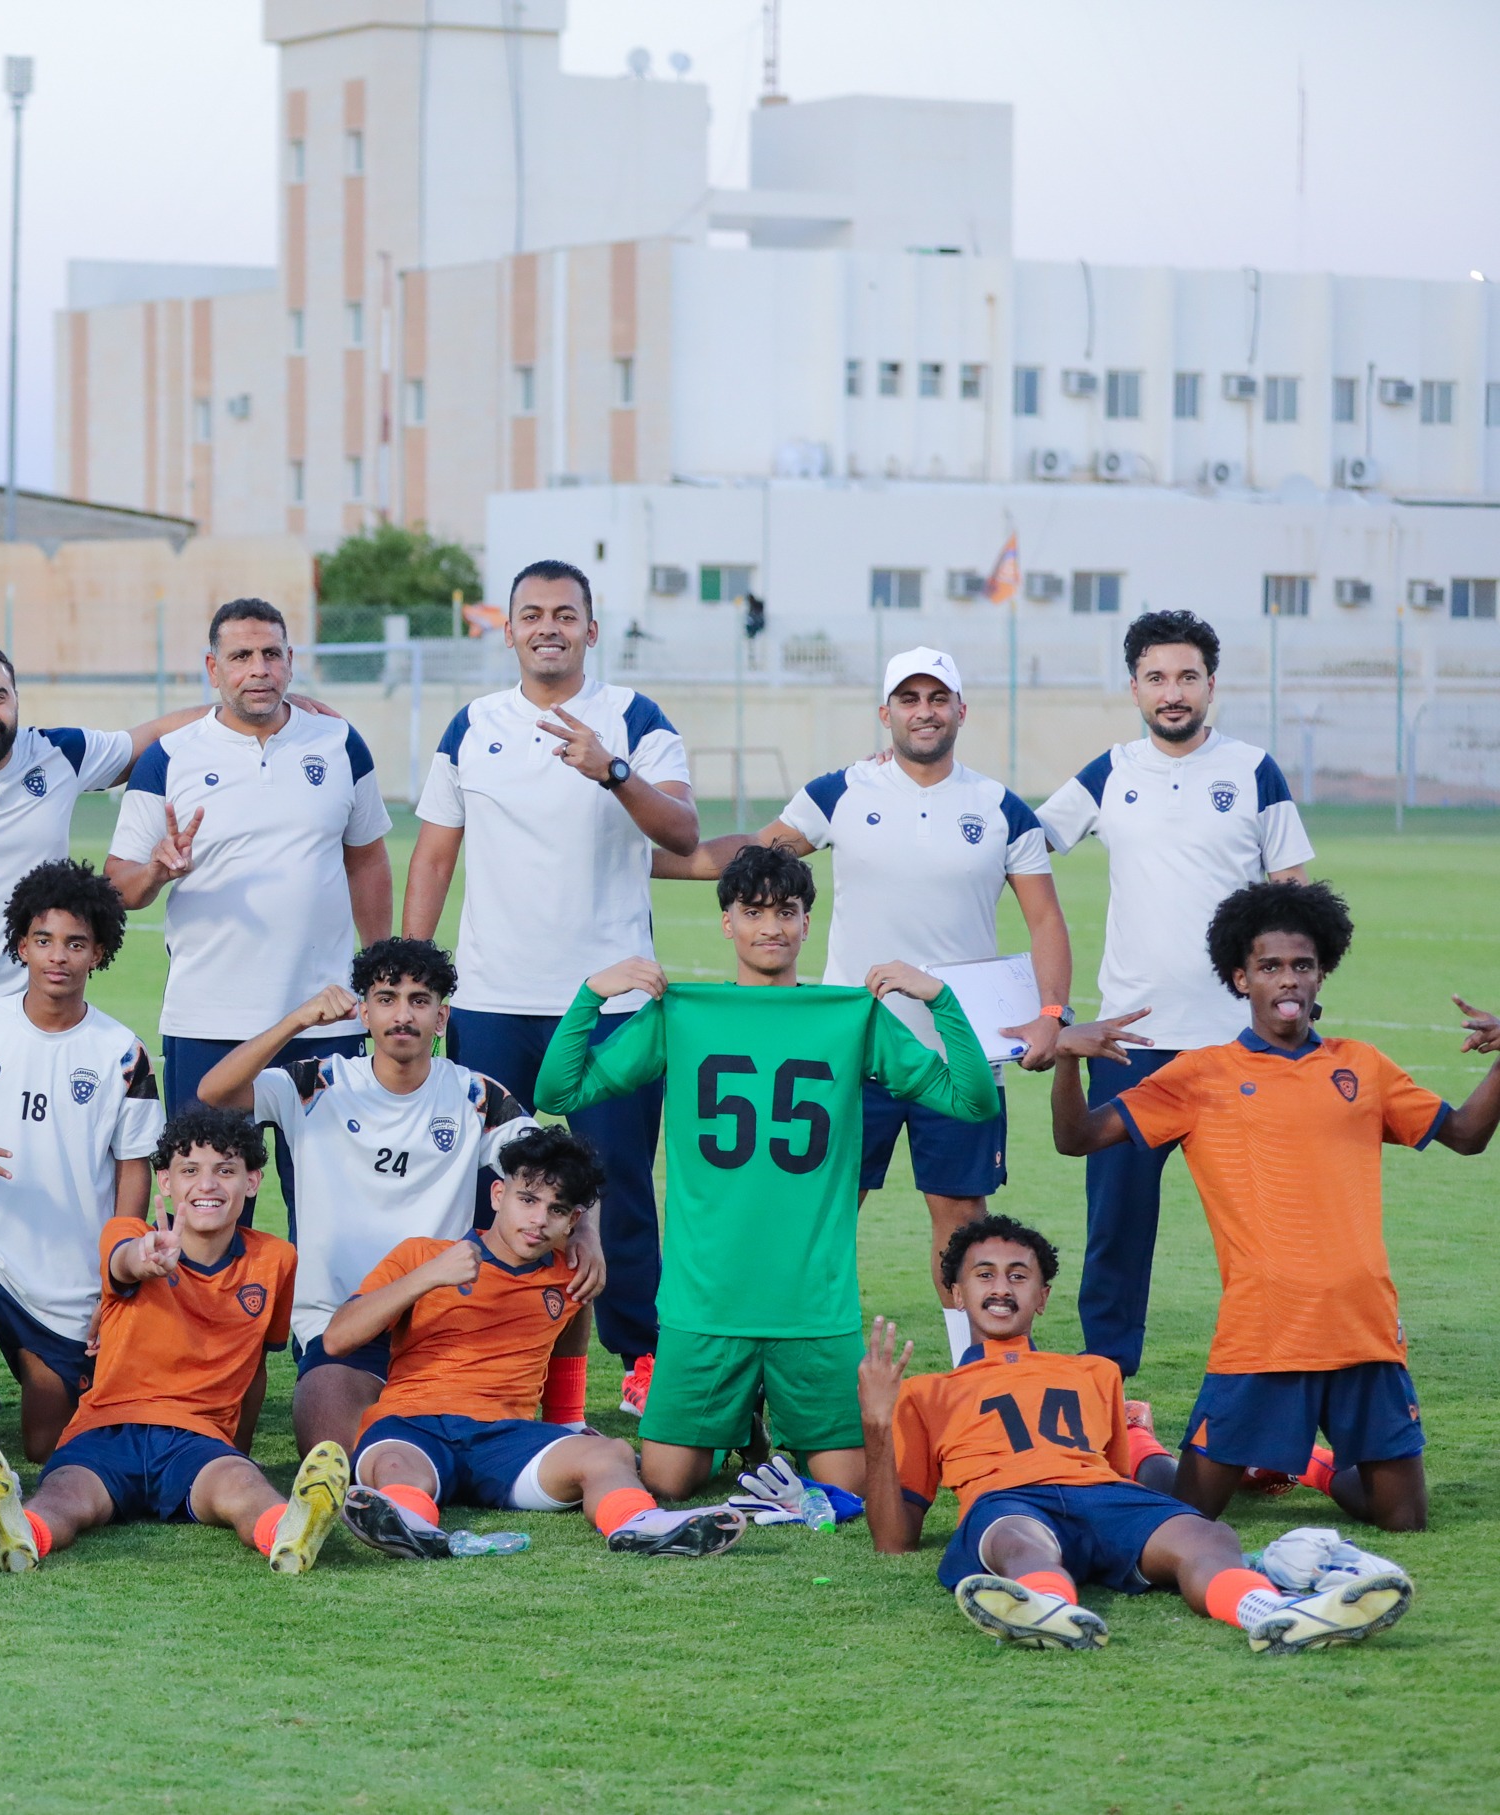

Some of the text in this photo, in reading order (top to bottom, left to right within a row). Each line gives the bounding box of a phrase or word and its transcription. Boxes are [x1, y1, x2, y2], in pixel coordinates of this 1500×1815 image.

[21, 1091, 48, 1122] 18
[696, 1054, 835, 1175] 55
[374, 1147, 410, 1178] 24
[979, 1387, 1095, 1453] 14
